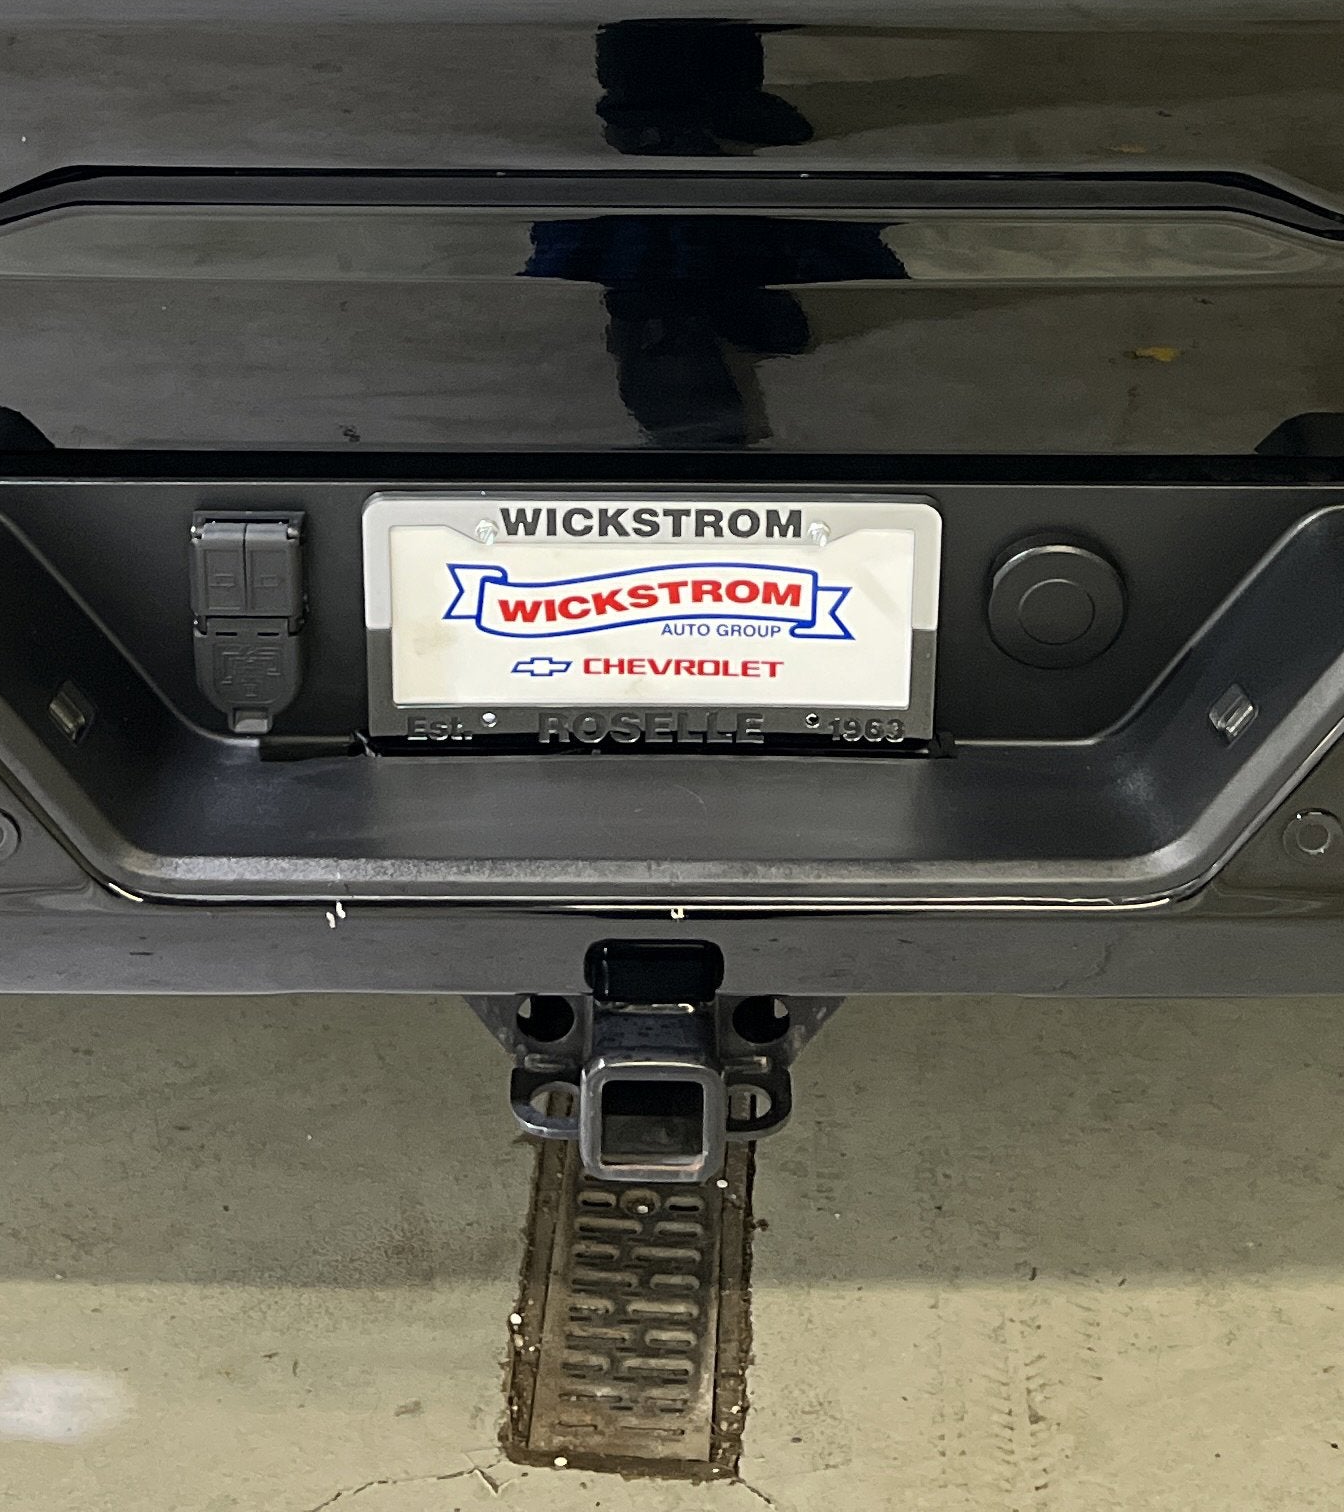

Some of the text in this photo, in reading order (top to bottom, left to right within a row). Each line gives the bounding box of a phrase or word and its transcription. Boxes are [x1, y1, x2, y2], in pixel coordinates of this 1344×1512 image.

[500, 508, 804, 538] WICKSTROM
[498, 579, 803, 624] WICKSTROM
[661, 623, 782, 640] AUTO GROUP
[582, 658, 785, 678] CHEVROLET
[407, 712, 907, 744] Est. ROSELLE 1963
